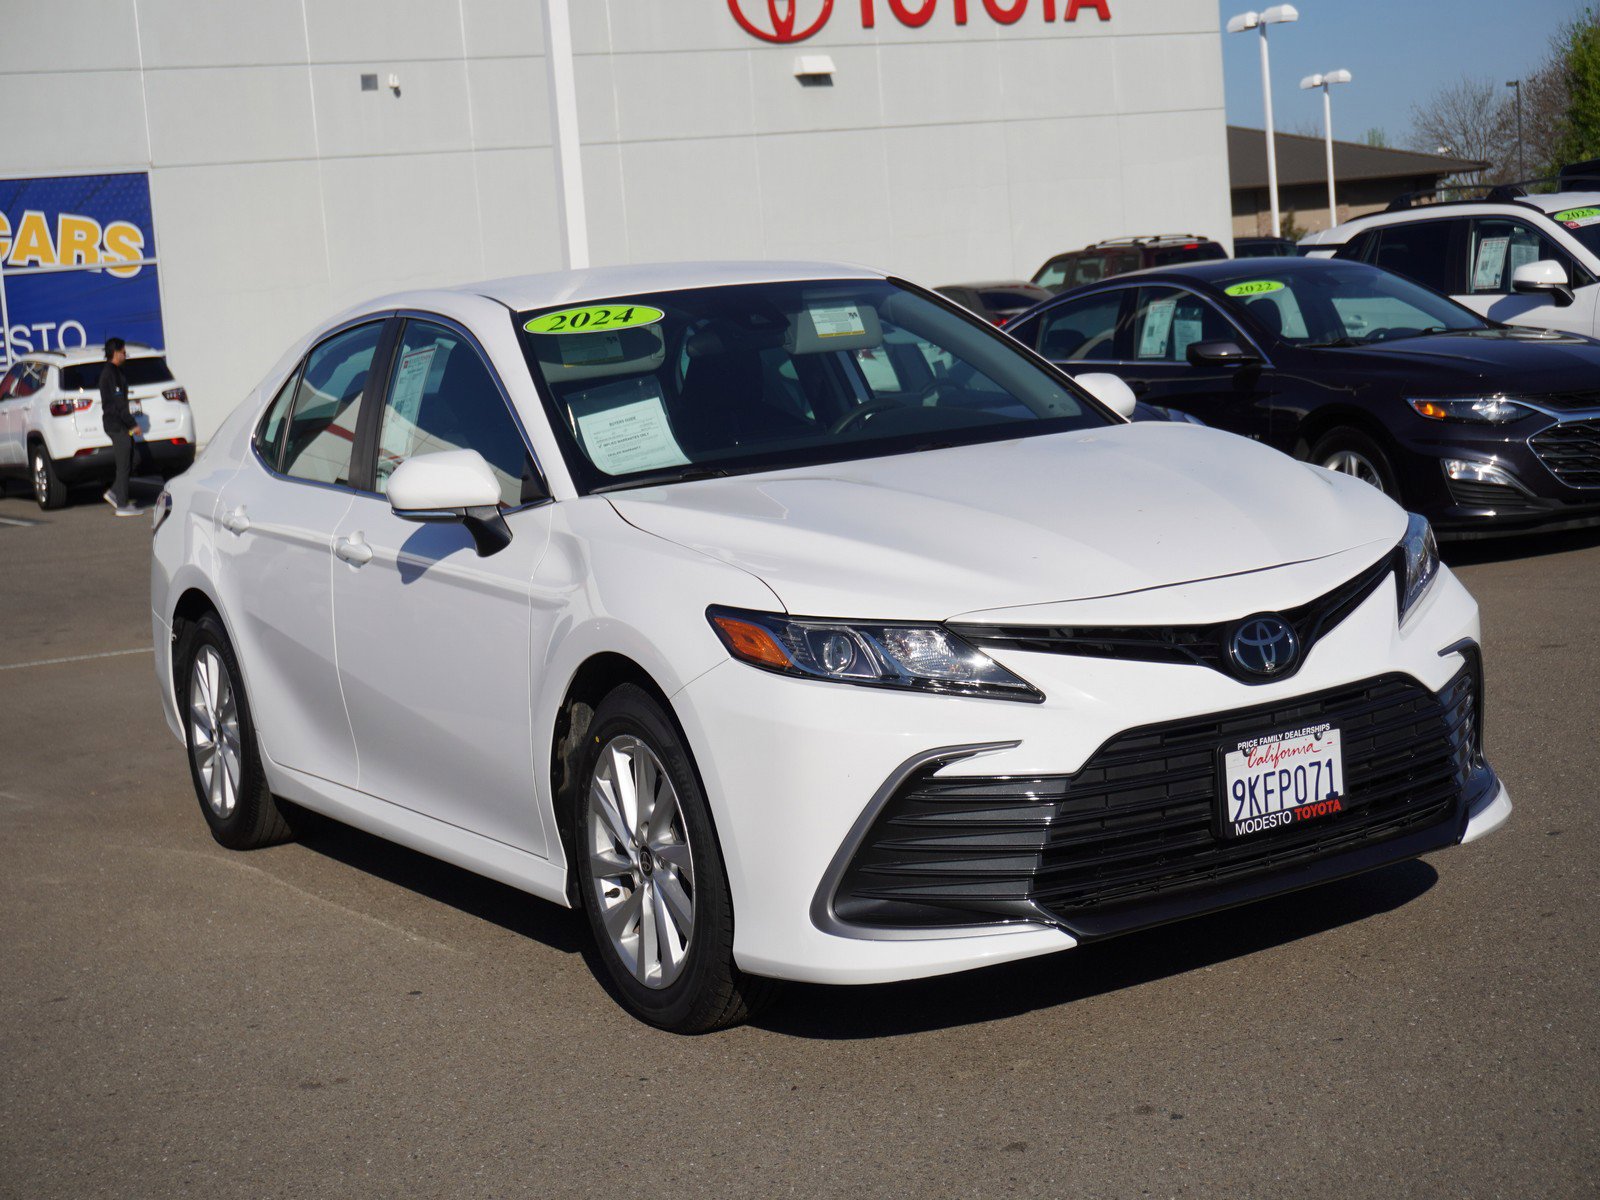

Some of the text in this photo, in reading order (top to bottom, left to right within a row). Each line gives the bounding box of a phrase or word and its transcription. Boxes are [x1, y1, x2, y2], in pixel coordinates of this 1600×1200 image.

[0, 209, 145, 278] ARS
[547, 307, 634, 332] 2024
[1237, 723, 1331, 751] PRICE FAMILY DEALERSHIPS
[1247, 740, 1321, 769] California
[1232, 758, 1339, 821] 9KFP071
[1235, 799, 1342, 836] MODESTO TOYOTA
